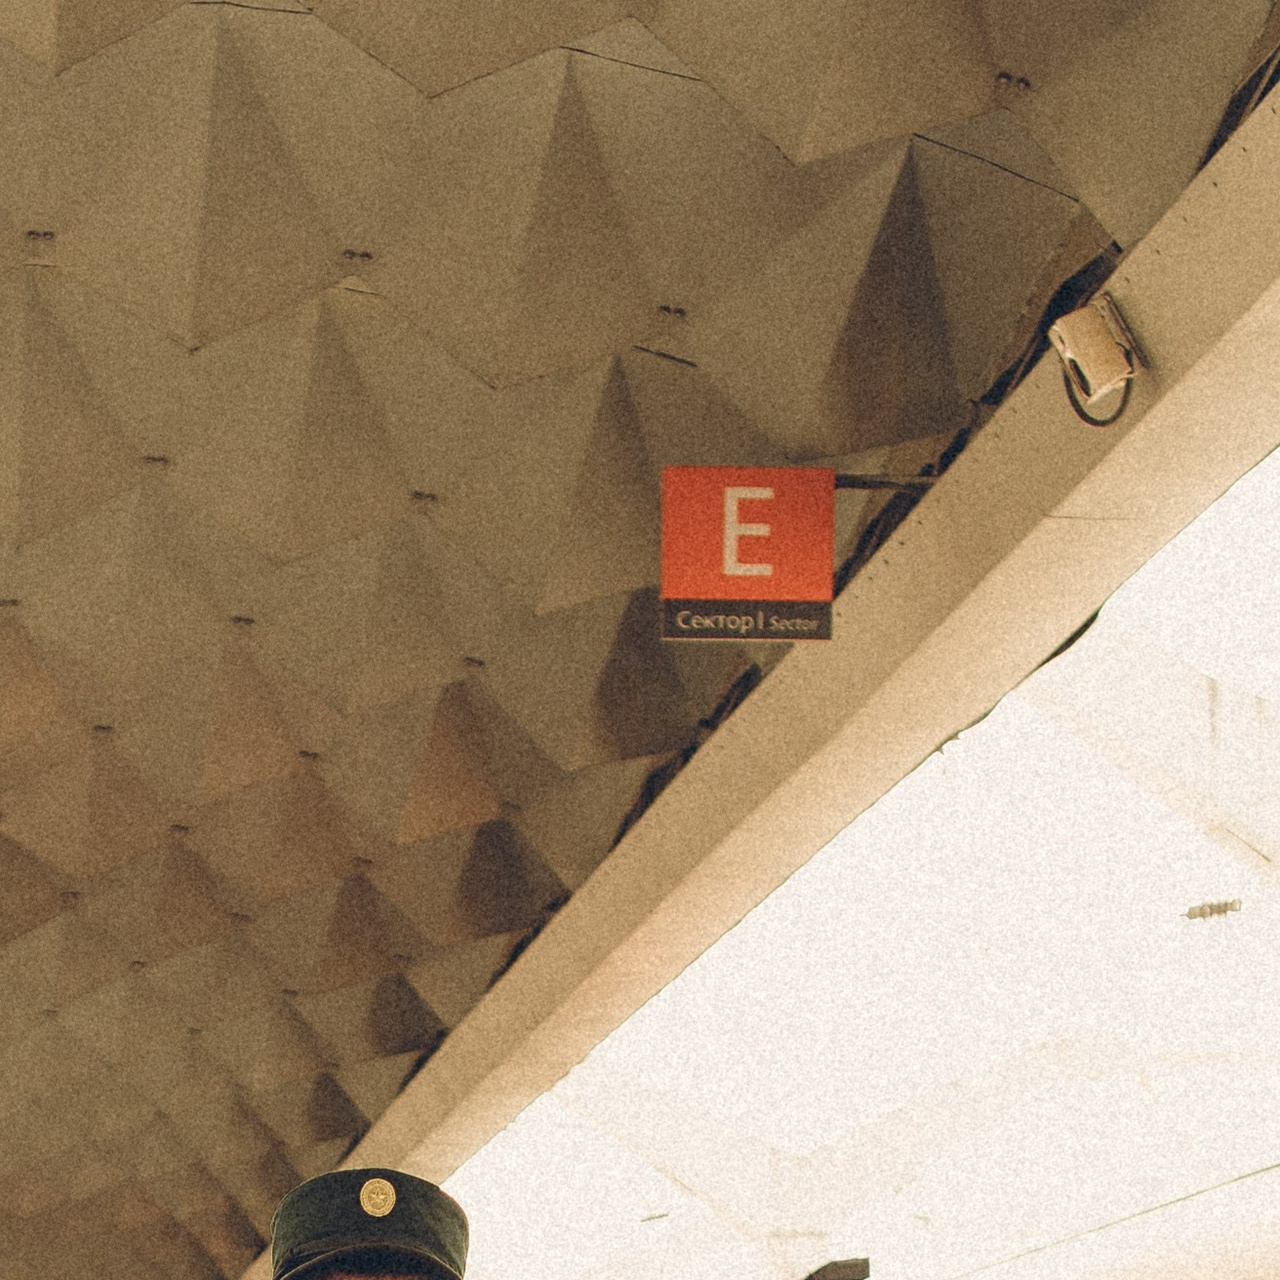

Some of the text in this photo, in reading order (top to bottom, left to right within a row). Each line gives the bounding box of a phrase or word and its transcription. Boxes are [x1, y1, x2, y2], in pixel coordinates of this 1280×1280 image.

[723, 486, 775, 576] E
[675, 610, 818, 634] Сектор Sector
